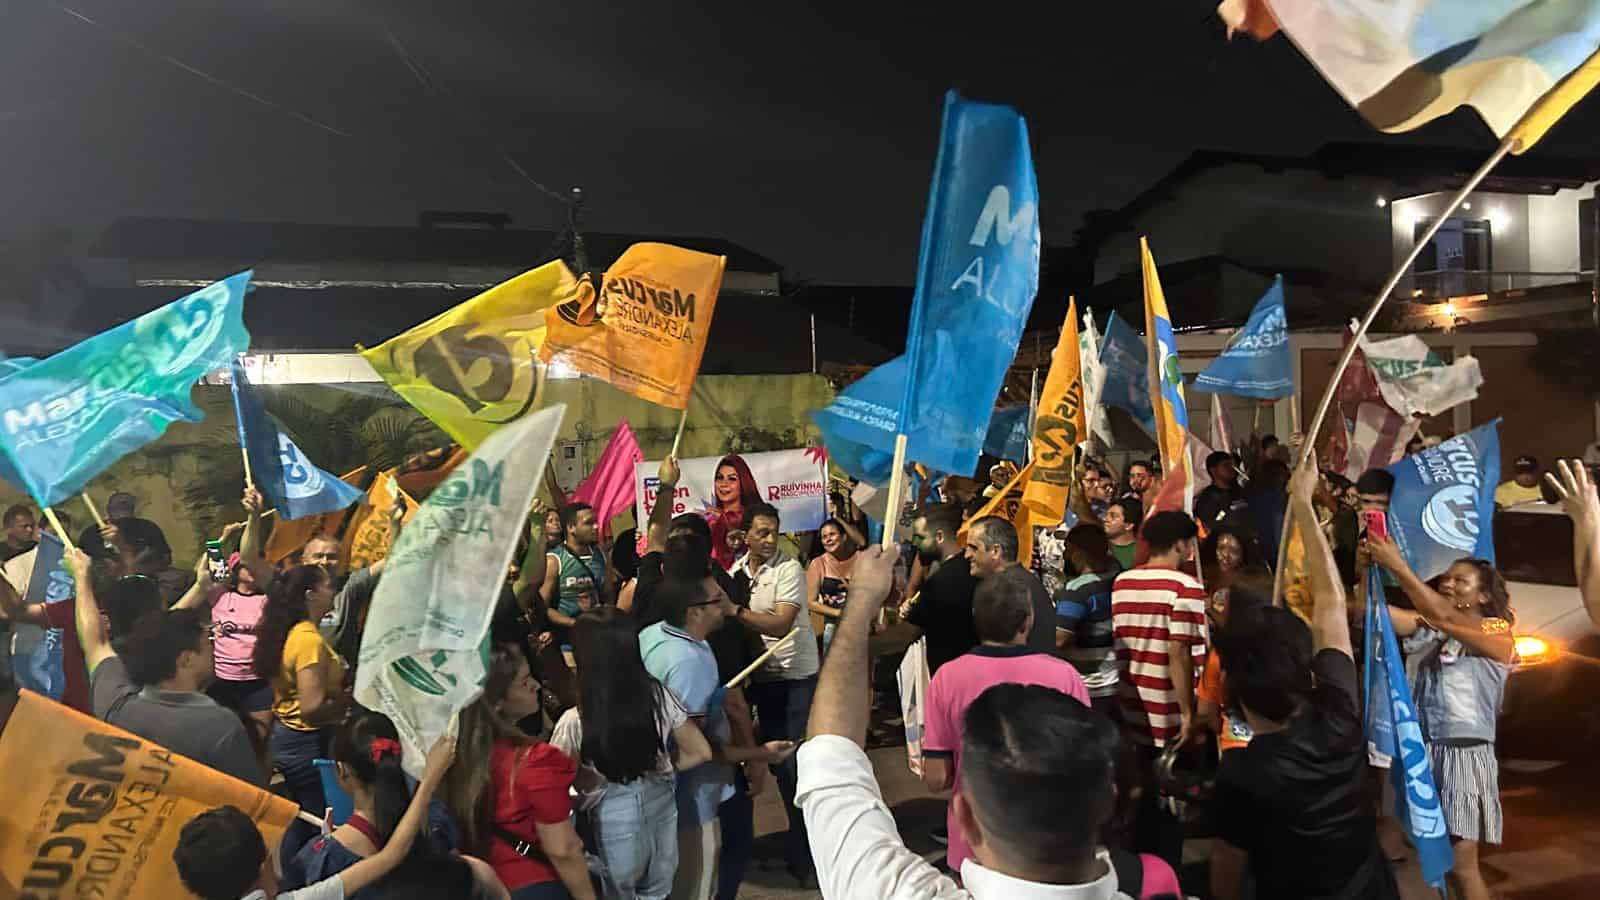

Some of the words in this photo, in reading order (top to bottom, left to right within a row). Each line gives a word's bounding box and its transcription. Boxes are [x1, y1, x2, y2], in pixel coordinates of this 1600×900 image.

[969, 185, 1036, 247] M
[780, 481, 822, 492] RUIVINHA
[644, 487, 690, 504] juen
